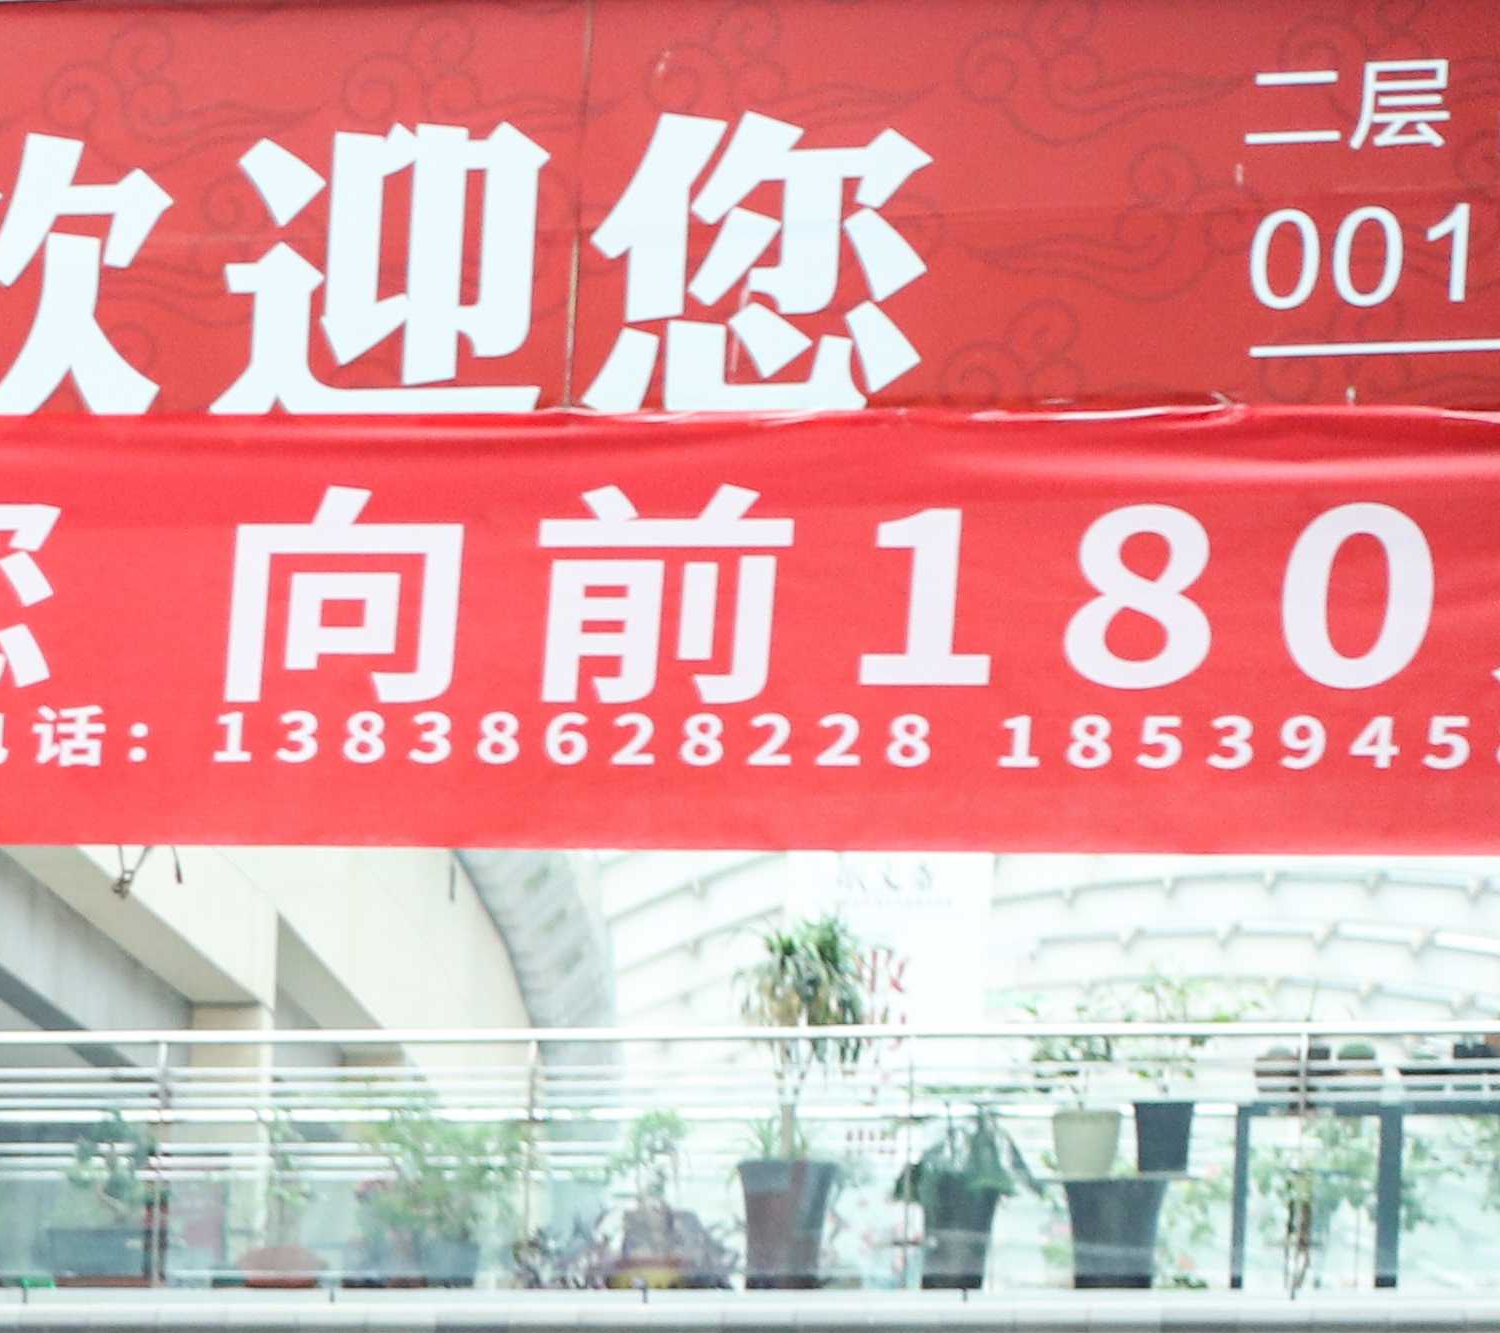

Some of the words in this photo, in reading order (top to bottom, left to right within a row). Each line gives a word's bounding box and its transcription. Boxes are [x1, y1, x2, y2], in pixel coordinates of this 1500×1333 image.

[1244, 58, 1451, 150] 二层
[1249, 202, 1471, 310] 001
[223, 484, 1500, 704] 向前180
[997, 714, 1500, 770] 1853945
